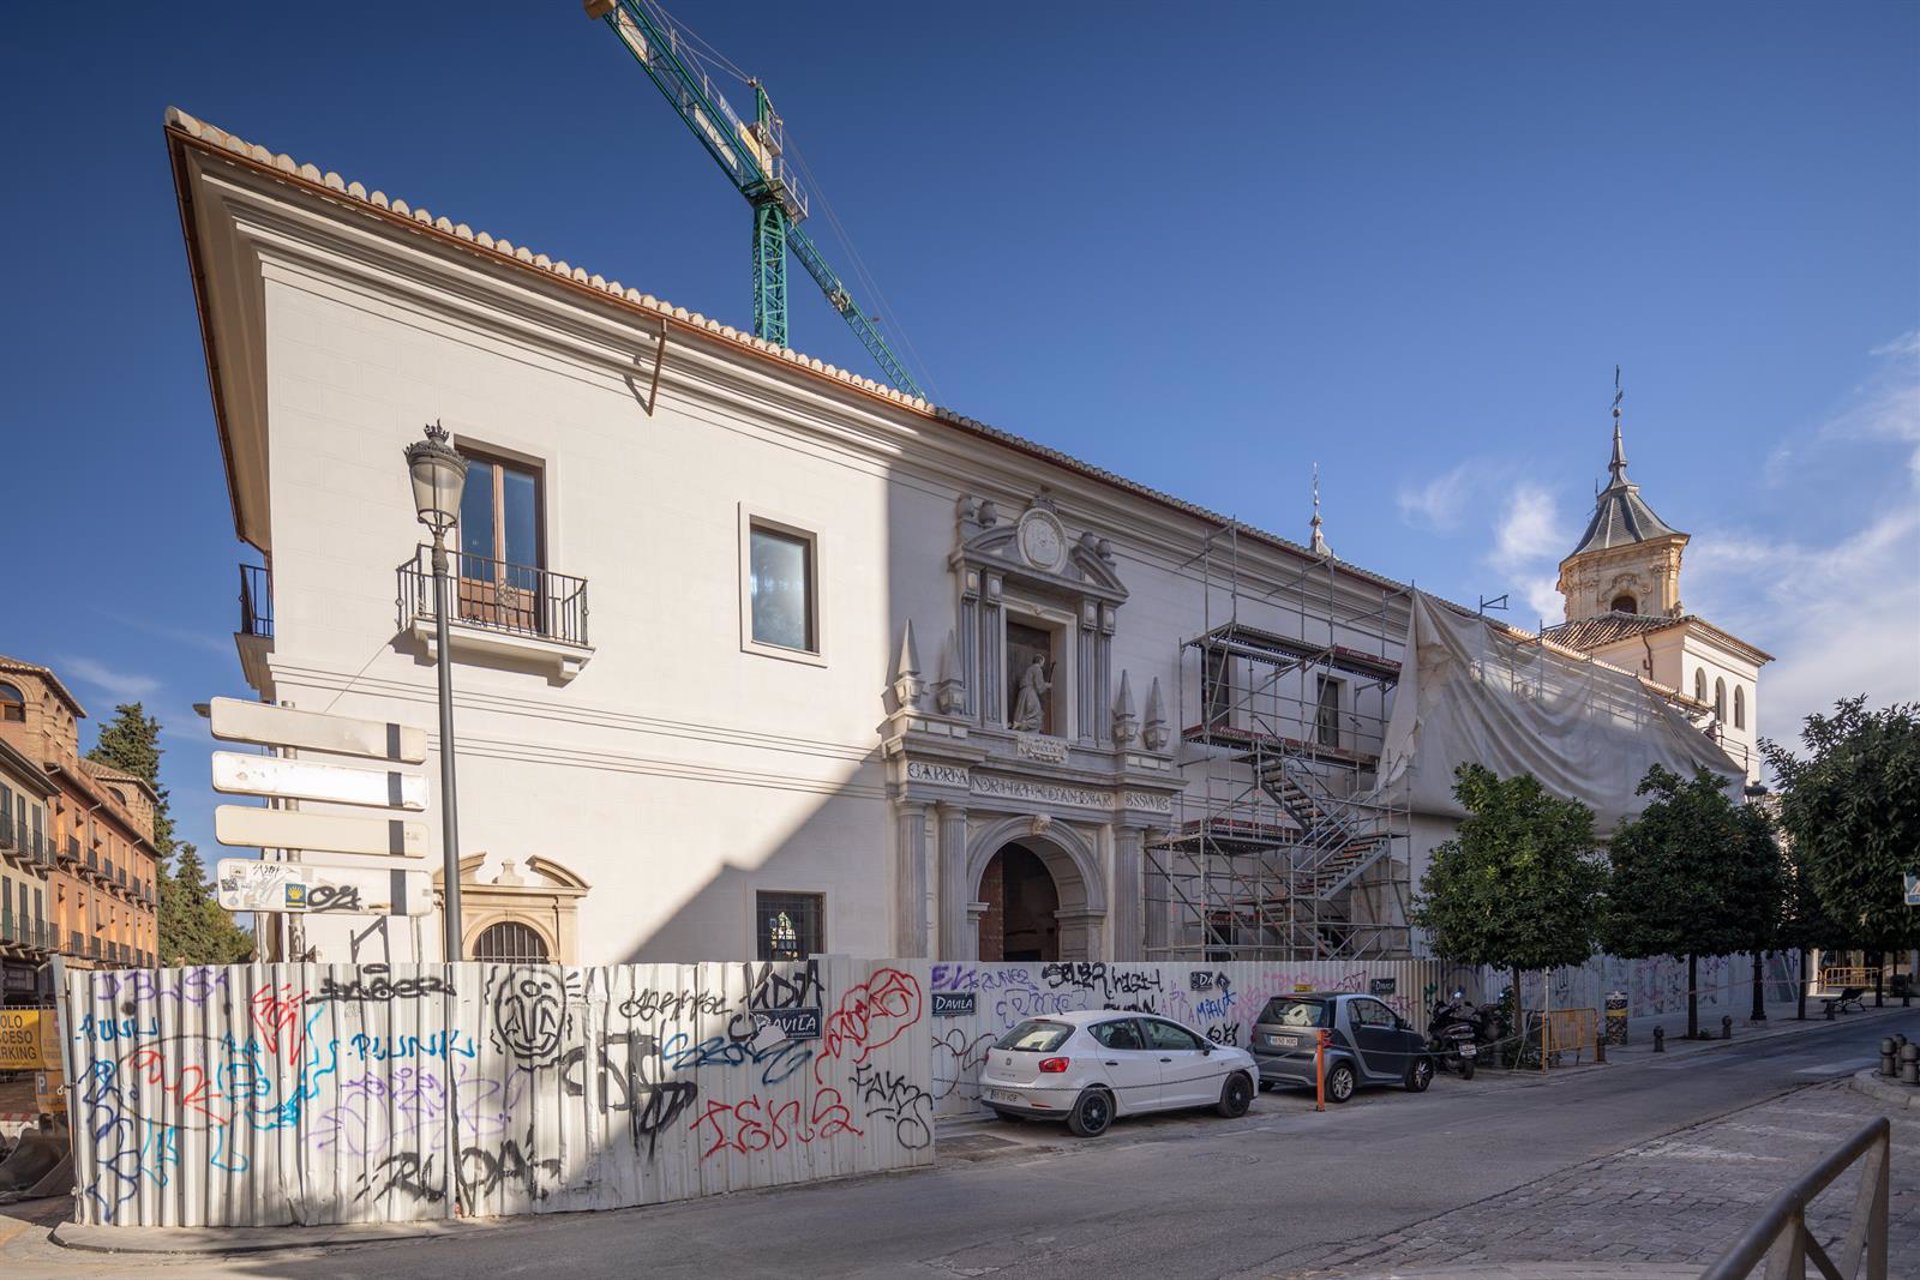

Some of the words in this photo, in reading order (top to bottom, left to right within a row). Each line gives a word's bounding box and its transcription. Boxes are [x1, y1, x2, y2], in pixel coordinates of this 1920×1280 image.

[0, 1015, 23, 1029] OLO
[758, 1016, 816, 1032] AVILA
[0, 1030, 33, 1044] CESO
[0, 1046, 37, 1060] RKING
